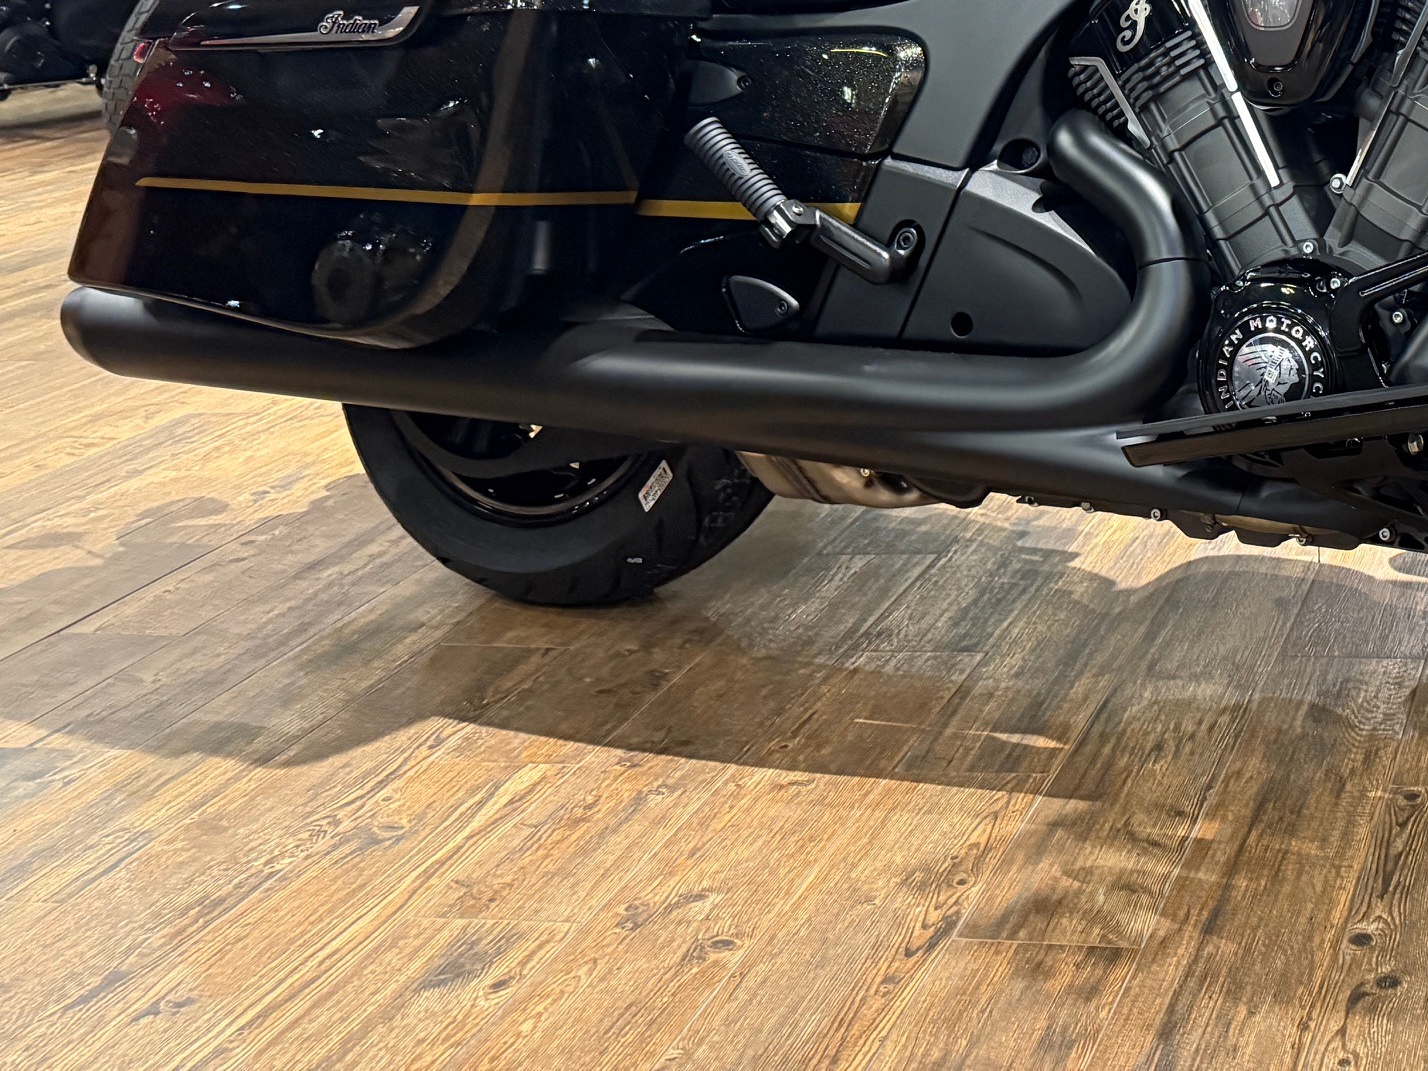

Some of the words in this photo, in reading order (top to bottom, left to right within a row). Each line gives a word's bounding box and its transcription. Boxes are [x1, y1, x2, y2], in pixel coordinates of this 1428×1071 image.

[318, 10, 379, 35] Indian
[1217, 329, 1244, 409] INDIAN
[1249, 315, 1325, 395] MOTORCYC
